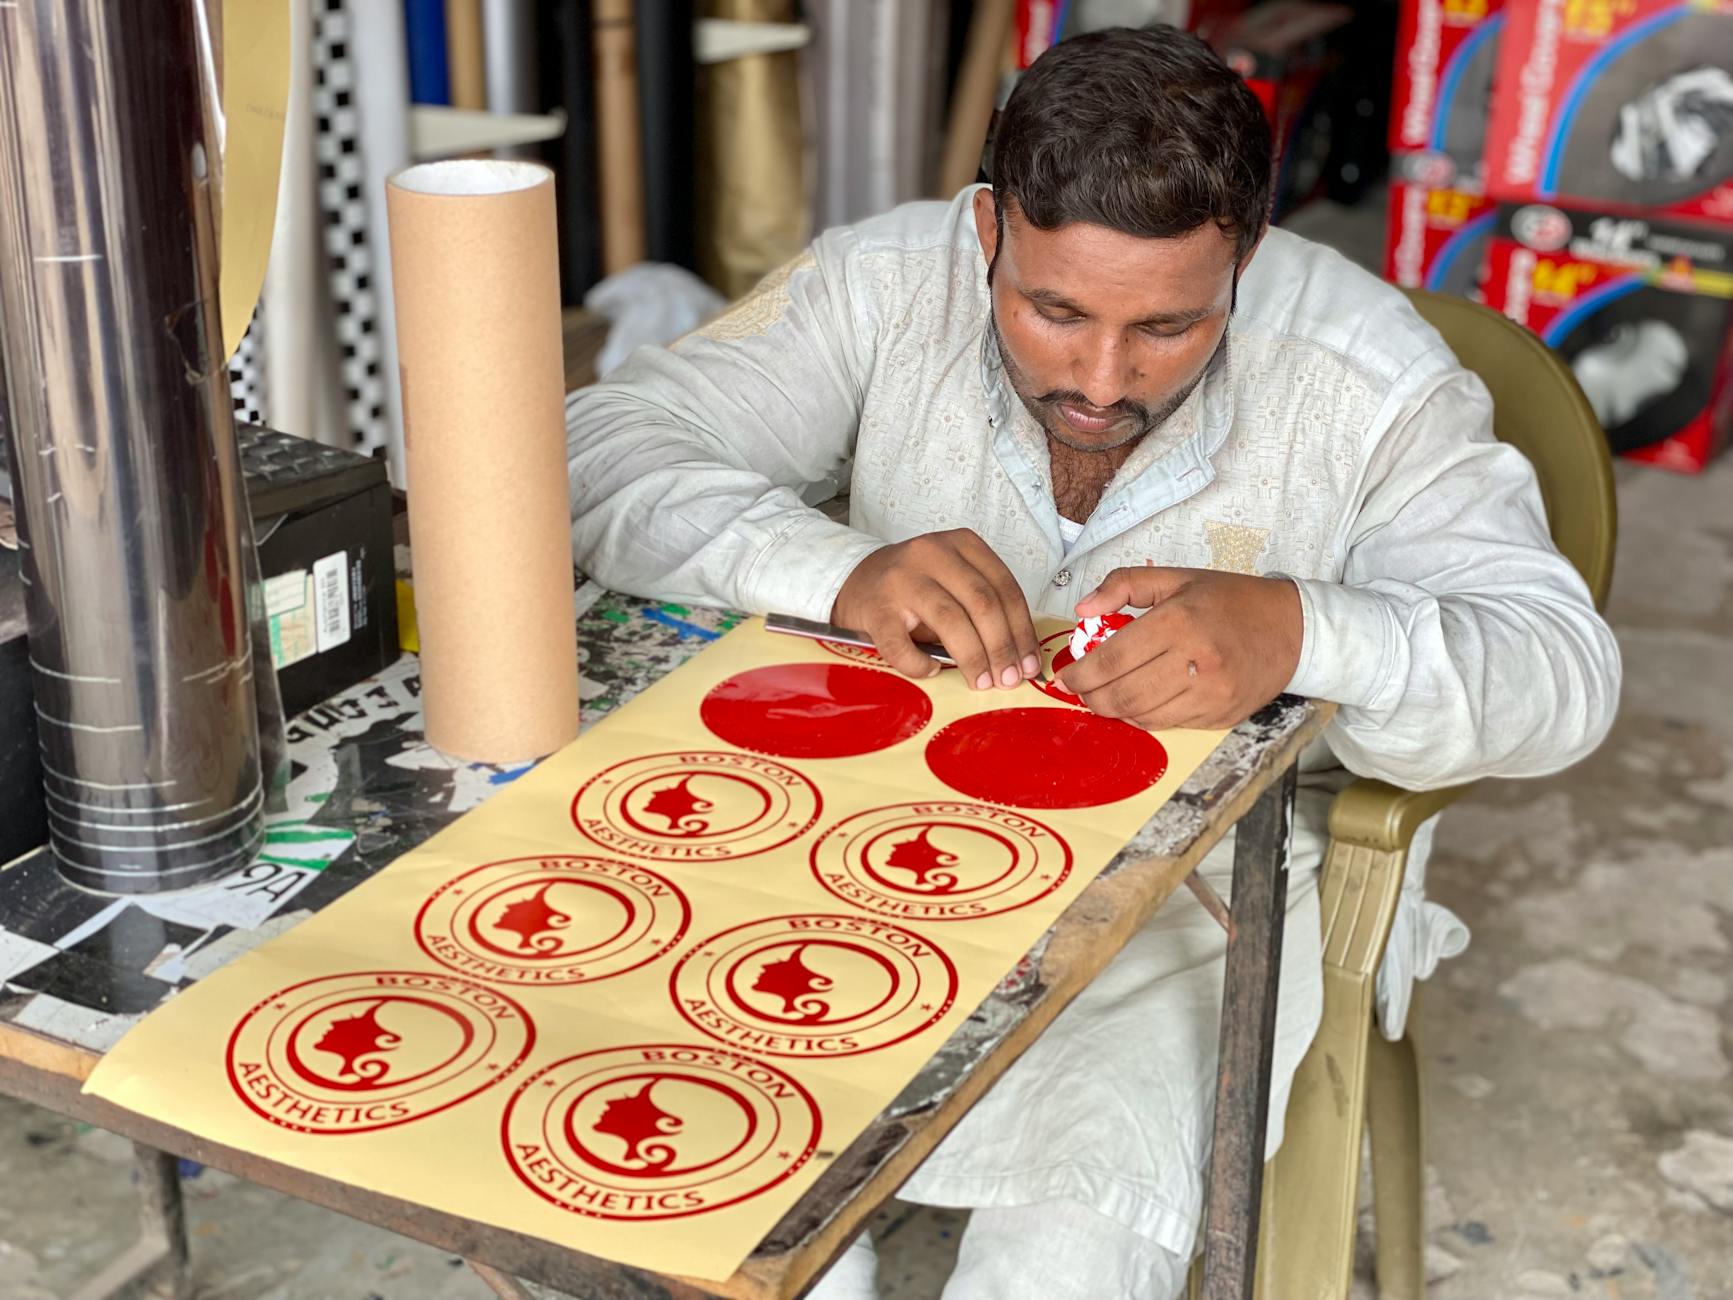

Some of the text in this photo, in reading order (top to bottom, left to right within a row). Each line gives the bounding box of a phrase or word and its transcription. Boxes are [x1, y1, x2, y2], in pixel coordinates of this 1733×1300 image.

[679, 752, 802, 789] BOSTON
[583, 817, 733, 857] AESTHETICS
[912, 803, 1047, 841] BOSTON
[538, 858, 672, 900] BOSTON
[823, 871, 988, 916] AESTHETICS
[427, 932, 588, 982] AESTHETICS
[788, 917, 932, 960] BOSTON
[375, 975, 516, 1021] BOSTON
[683, 996, 861, 1053] AESTHETICS
[238, 1060, 411, 1126] AESTHETICS
[640, 1049, 796, 1101] BOSTON
[515, 1142, 707, 1211] AESTHETICS
